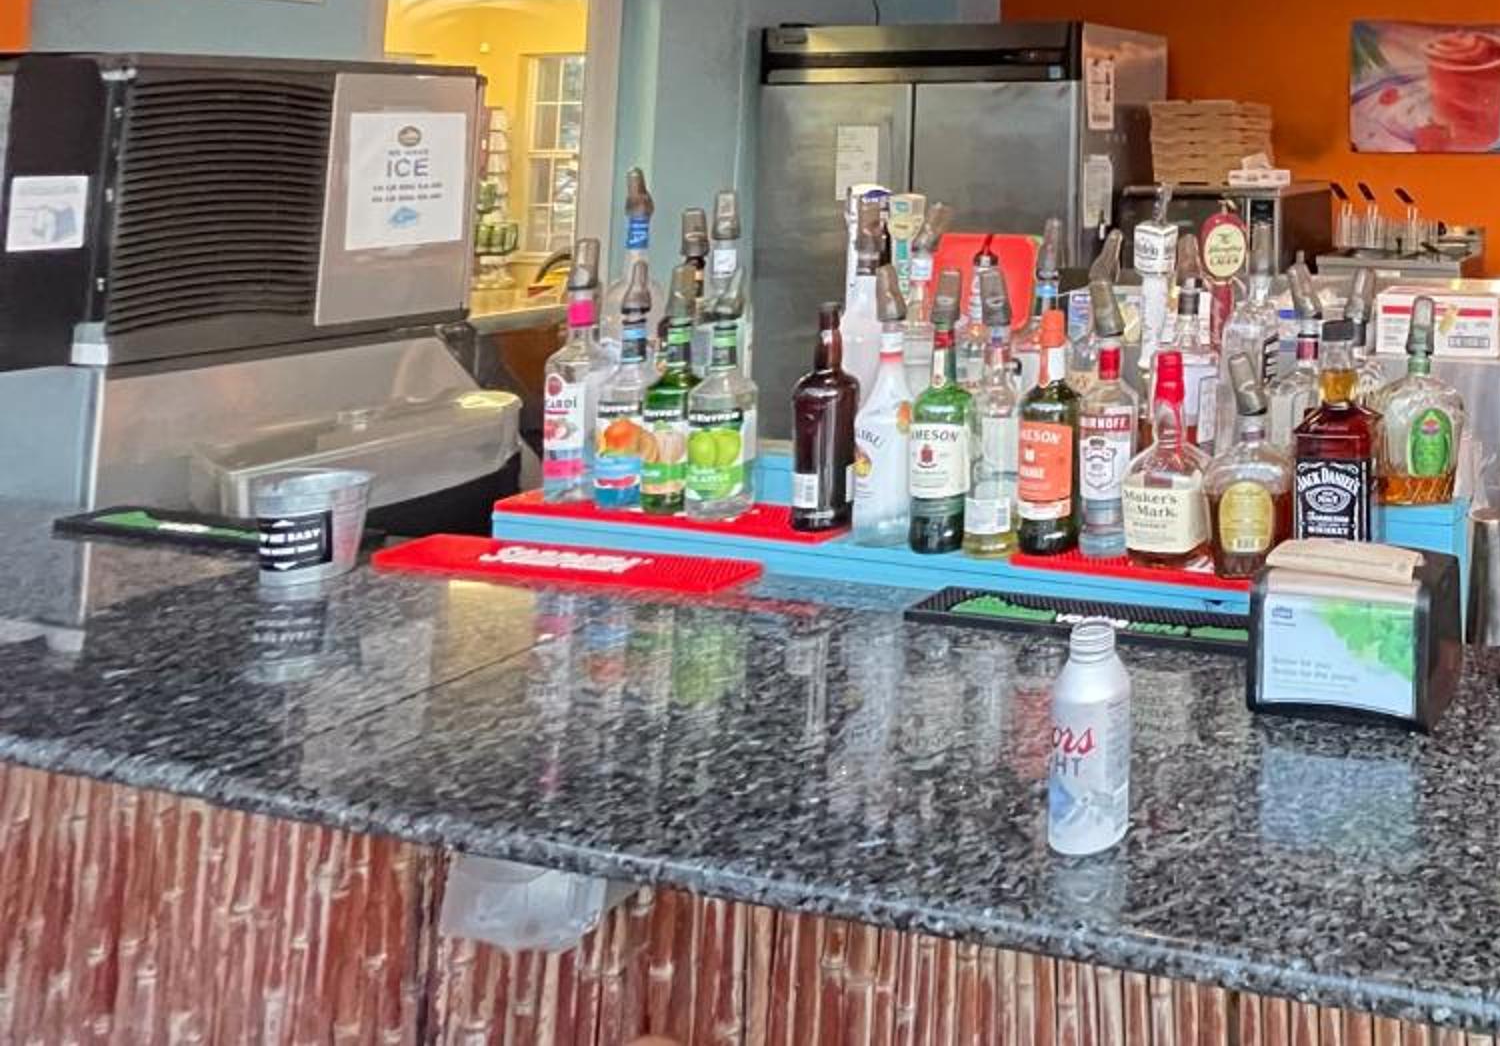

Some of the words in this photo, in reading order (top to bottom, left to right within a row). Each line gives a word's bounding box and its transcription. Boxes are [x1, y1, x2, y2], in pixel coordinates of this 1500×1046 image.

[387, 157, 429, 177] ICE
[911, 429, 958, 443] MESON
[1123, 489, 1178, 505] Maker's
[1051, 726, 1096, 755] ors
